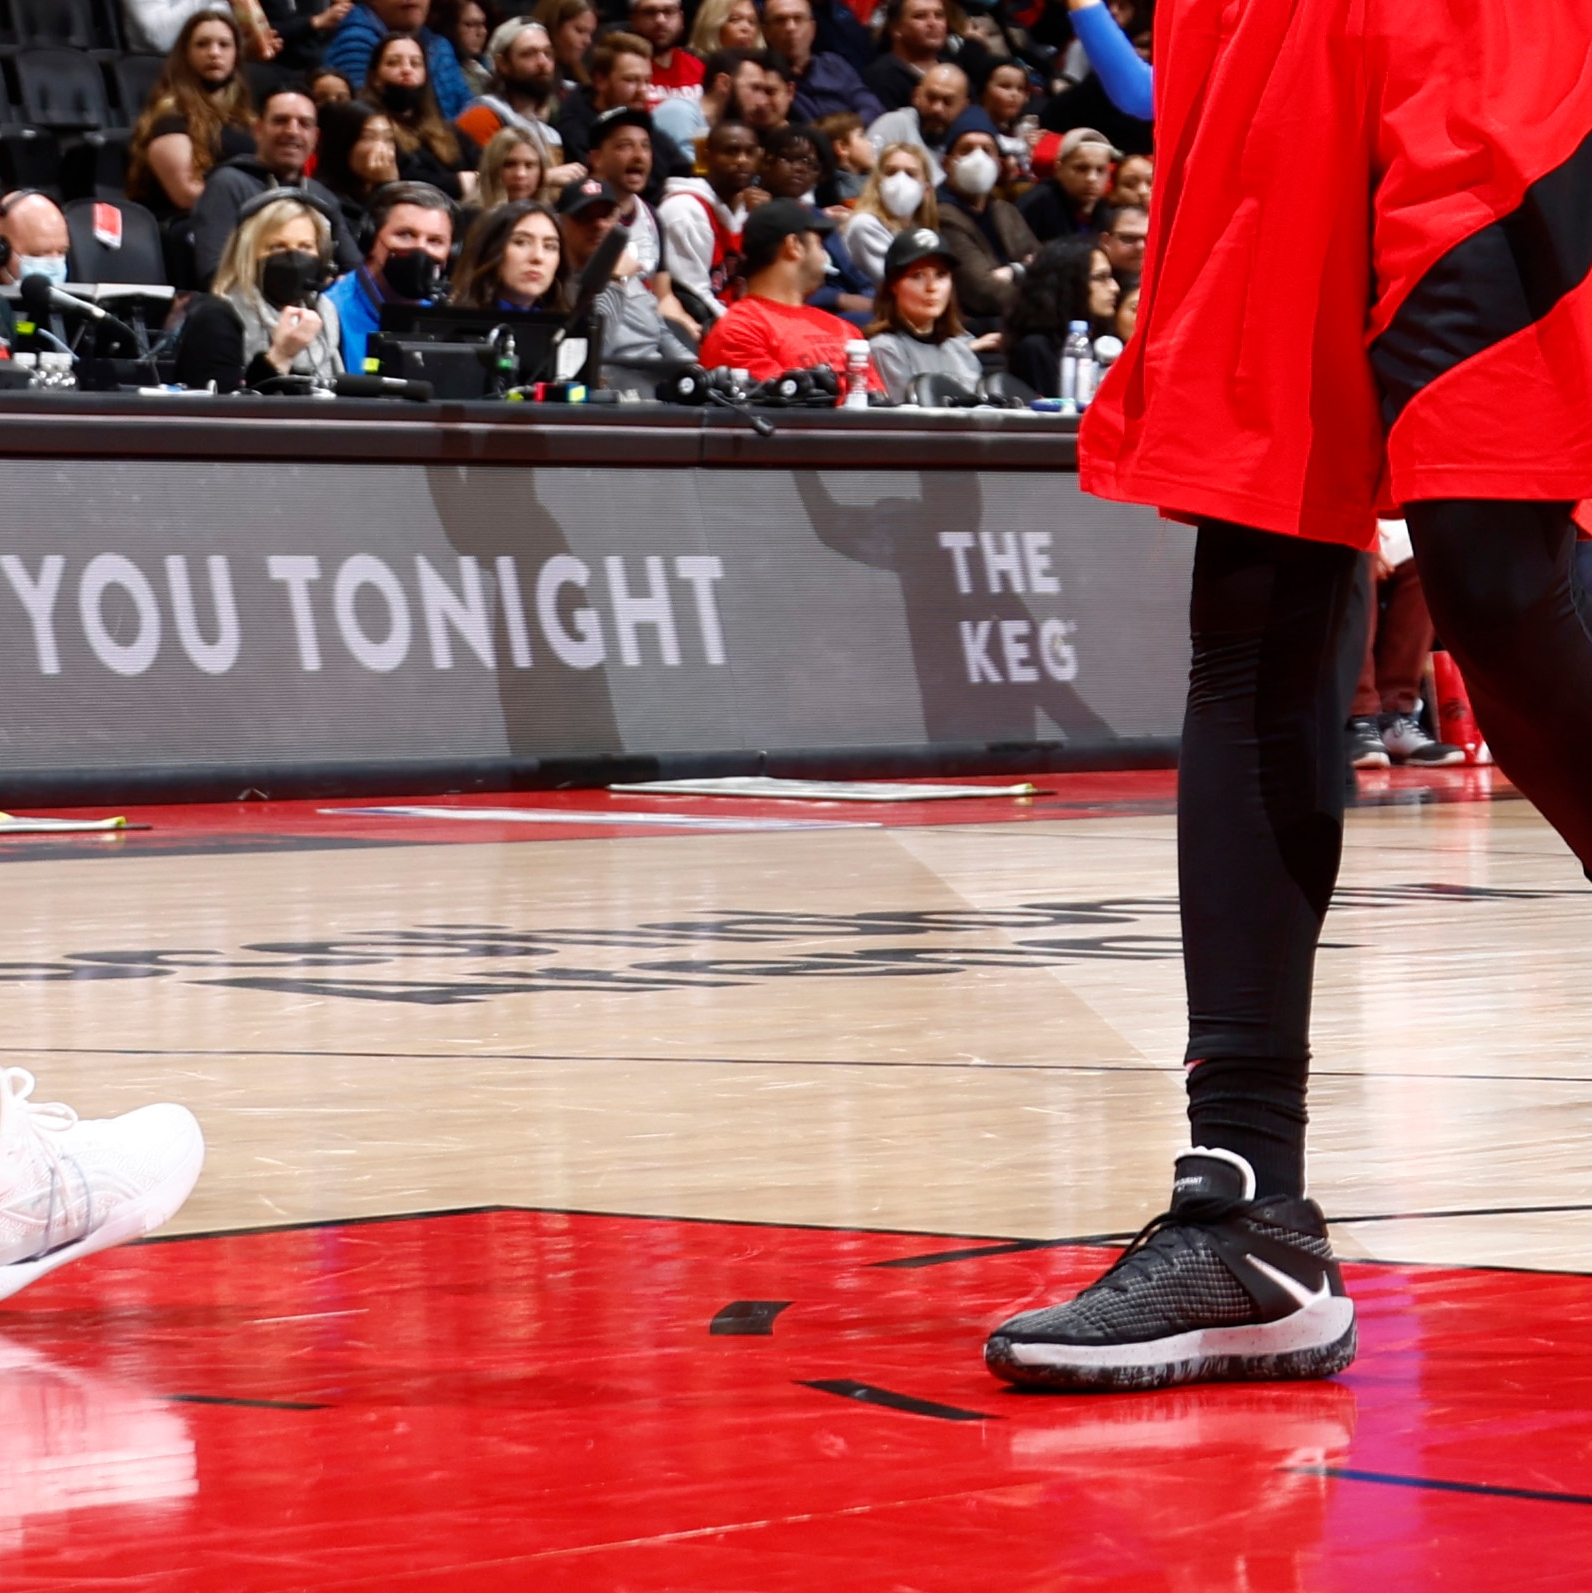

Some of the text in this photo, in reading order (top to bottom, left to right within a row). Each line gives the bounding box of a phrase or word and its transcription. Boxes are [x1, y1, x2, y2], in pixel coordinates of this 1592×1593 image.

[937, 531, 1063, 595] THE
[266, 552, 726, 673] TONIGHT
[958, 619, 1079, 683] KEG
